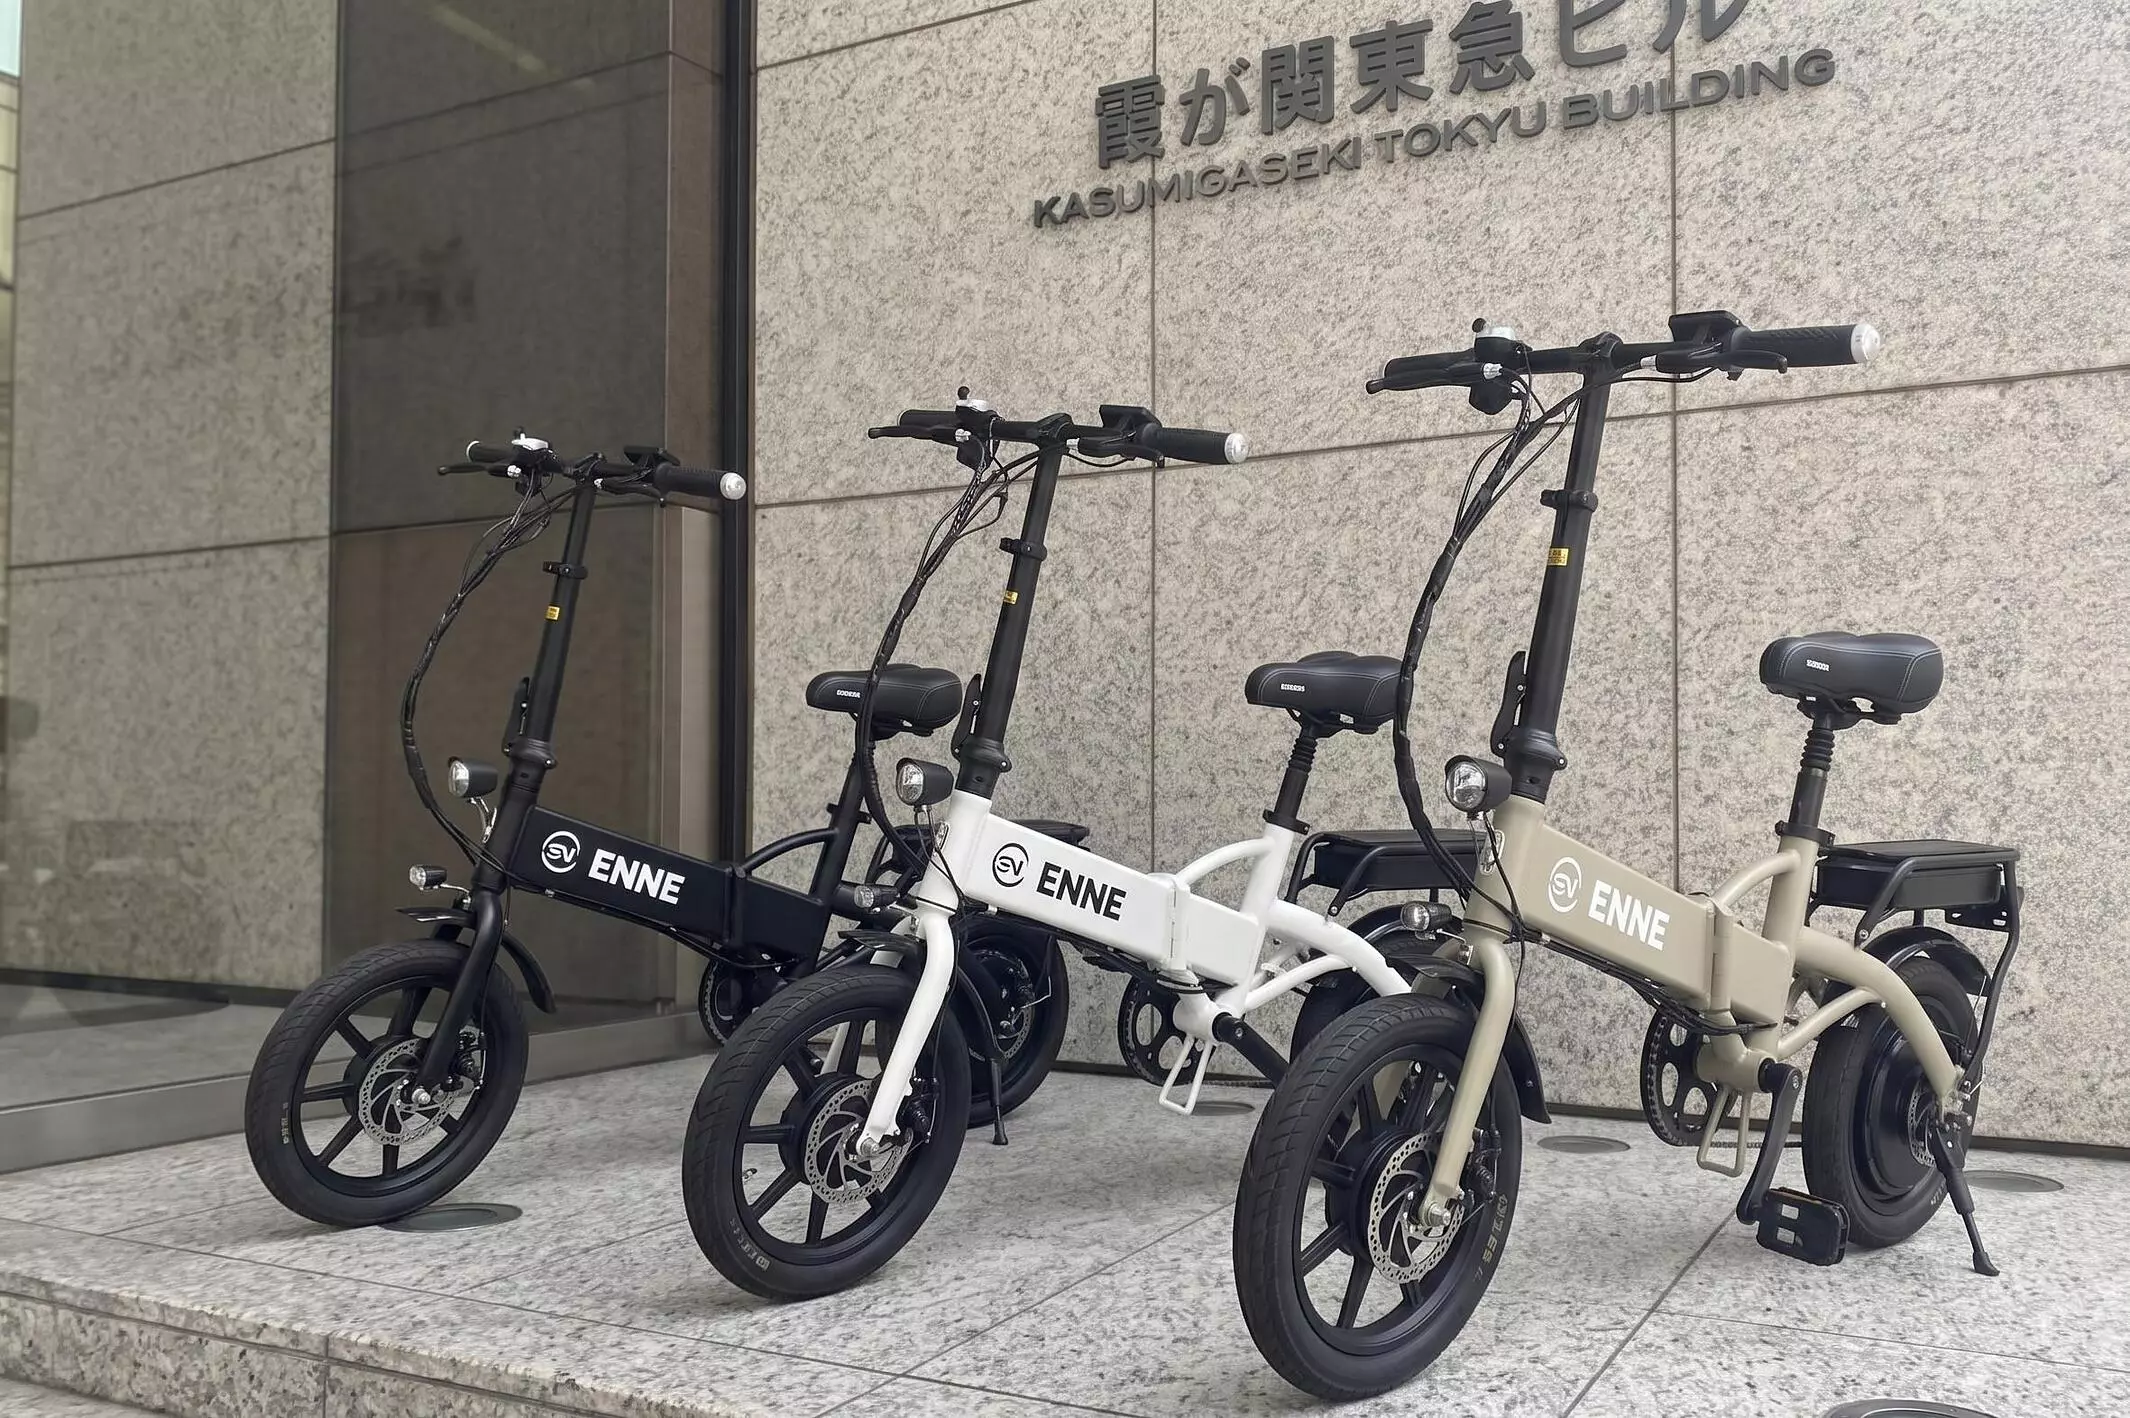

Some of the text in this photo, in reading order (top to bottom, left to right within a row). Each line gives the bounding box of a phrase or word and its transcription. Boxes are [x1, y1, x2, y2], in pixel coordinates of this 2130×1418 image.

[1033, 48, 1836, 228] KASUMIGASEKI TOKYU BUILDING
[588, 848, 686, 905] ENNE
[1036, 861, 1127, 921] ENNE
[1588, 879, 1670, 951] ENNE
